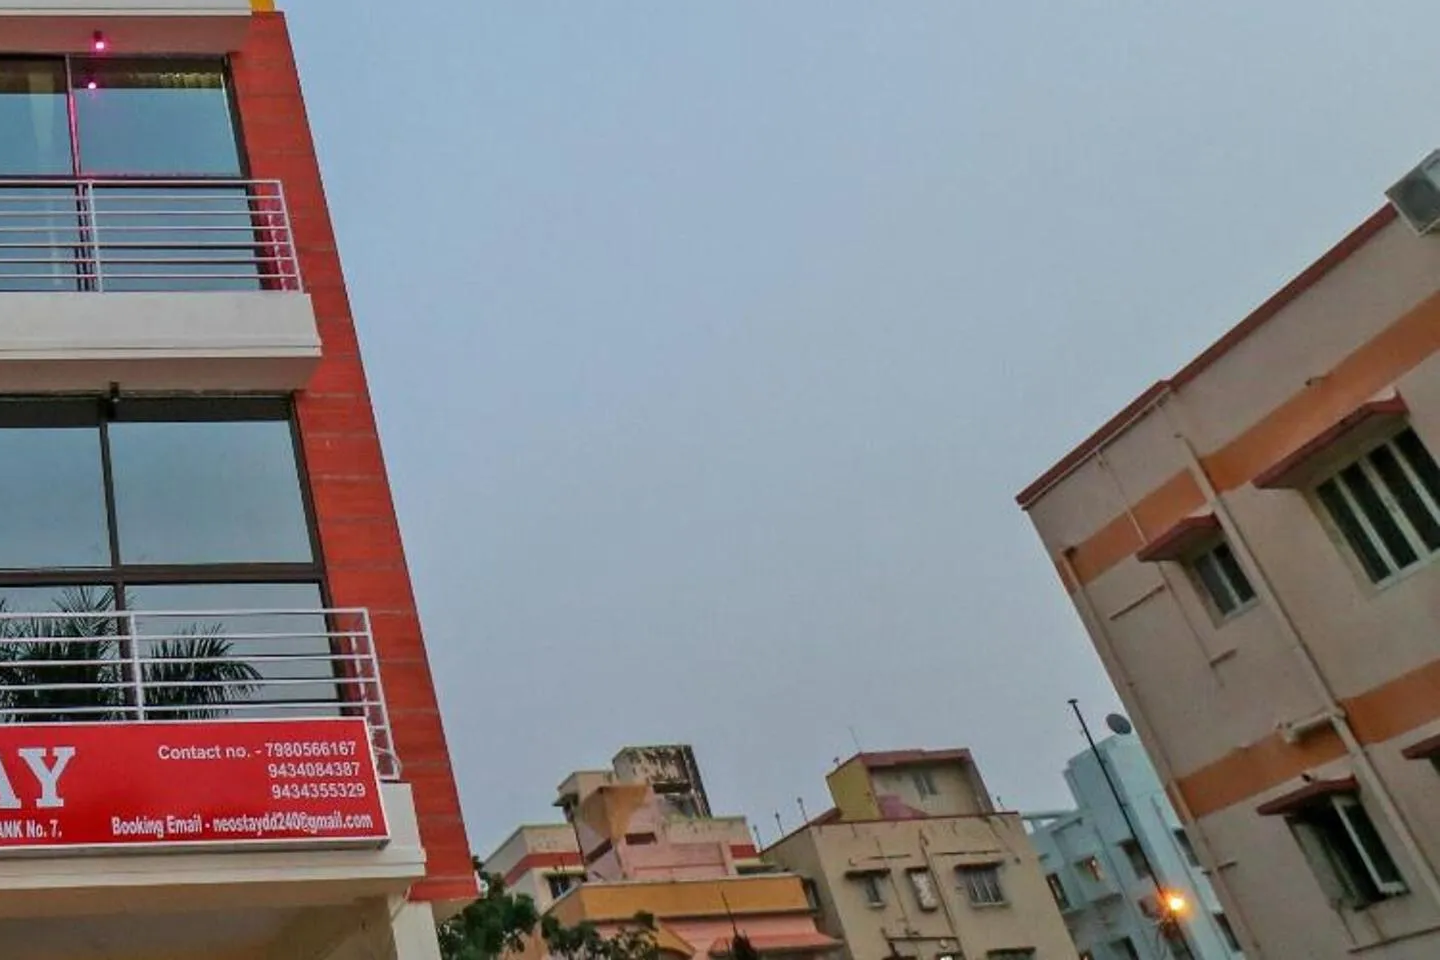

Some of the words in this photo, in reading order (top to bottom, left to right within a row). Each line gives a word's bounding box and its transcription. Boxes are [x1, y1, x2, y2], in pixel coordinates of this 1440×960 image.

[158, 745, 221, 760] Contact
[226, 744, 250, 758] no.
[265, 741, 356, 757] 7980566167
[268, 762, 360, 778] 9434084387
[271, 783, 366, 799] 9434355329
[26, 820, 47, 838] No.
[111, 816, 164, 838] Booking
[166, 813, 202, 834] Email
[213, 810, 373, 836] neostaydd240@gmail.com
